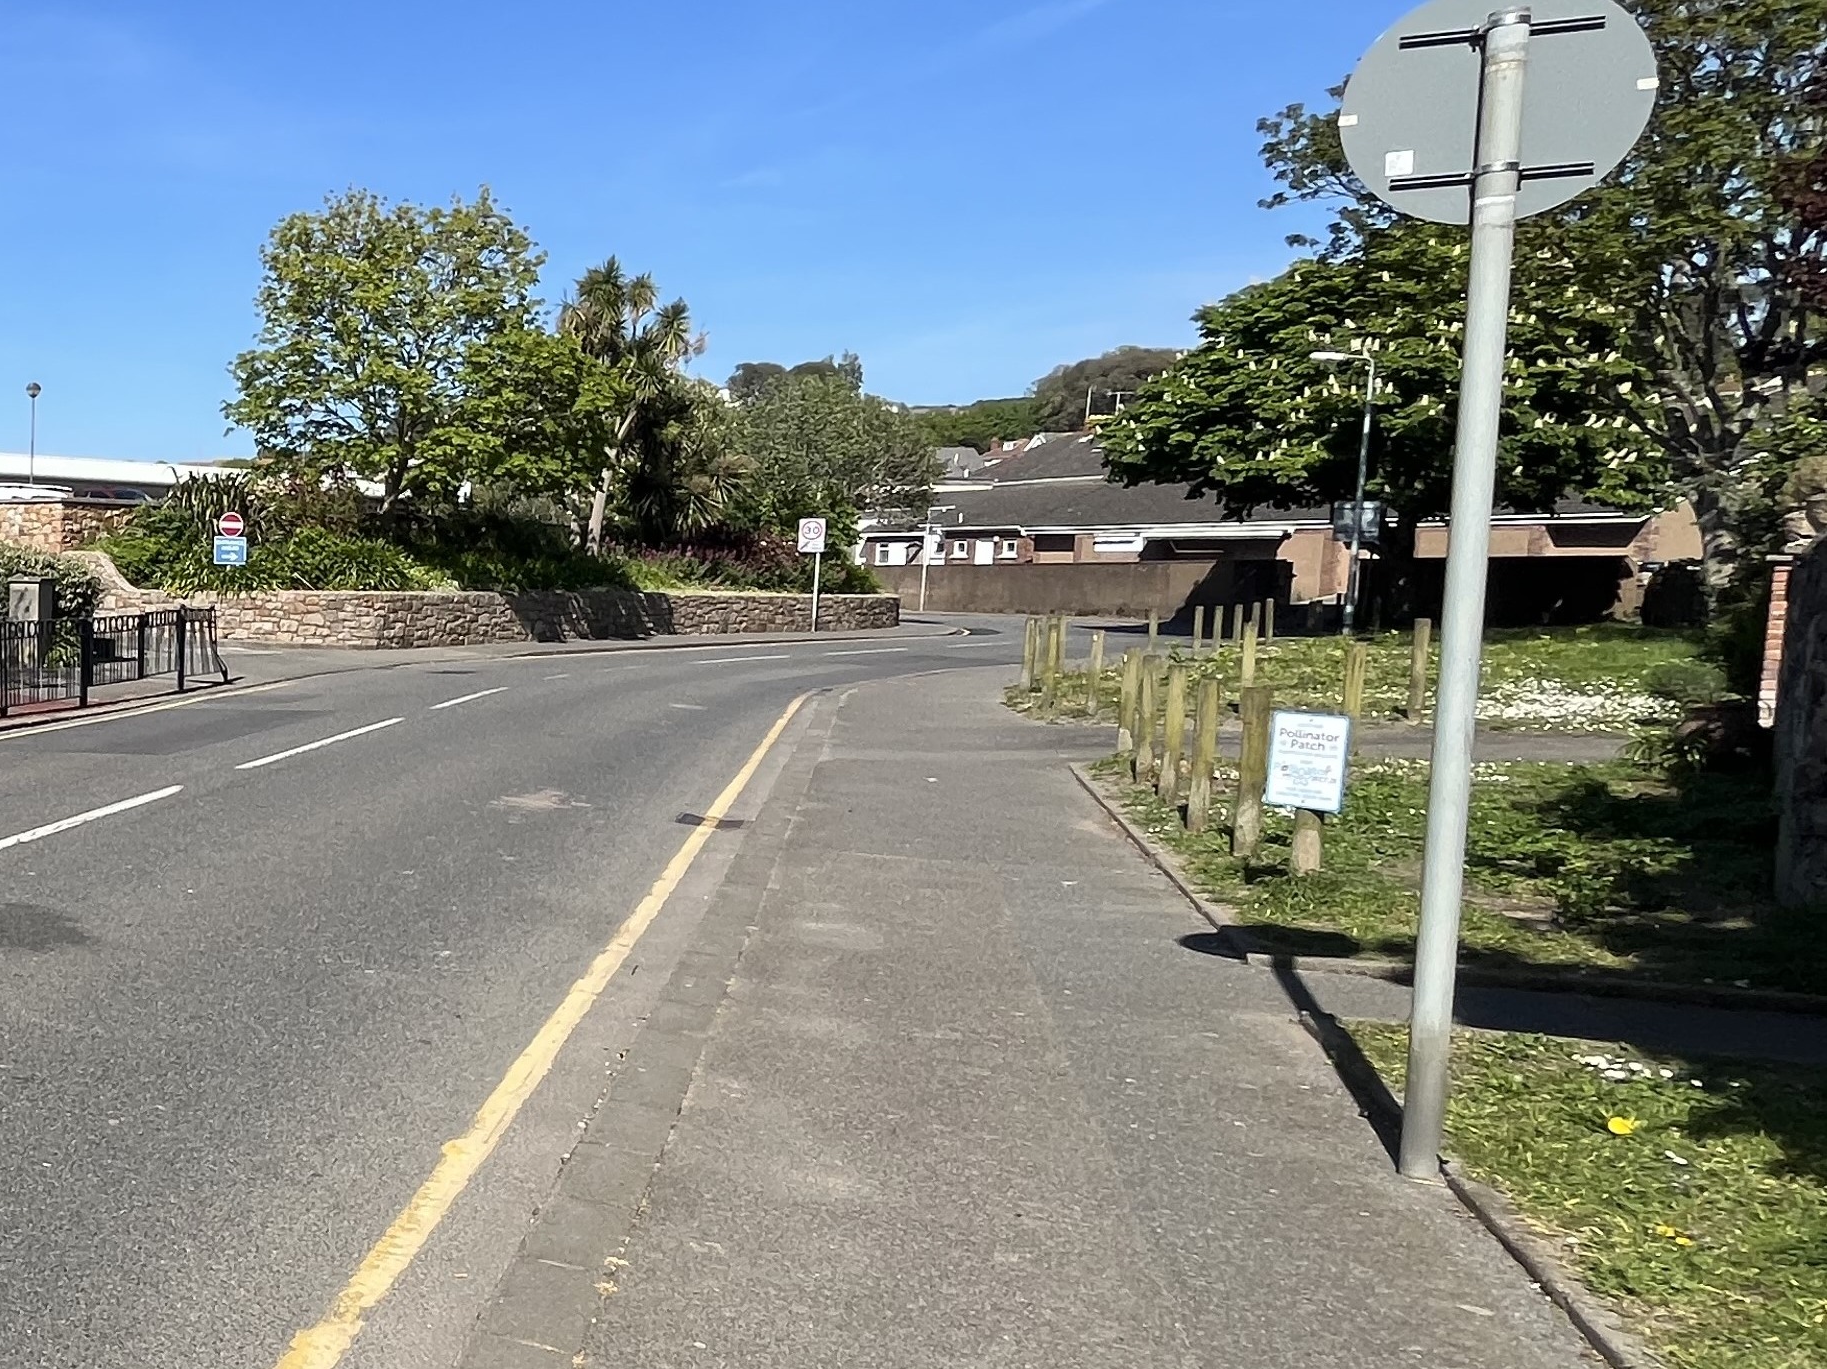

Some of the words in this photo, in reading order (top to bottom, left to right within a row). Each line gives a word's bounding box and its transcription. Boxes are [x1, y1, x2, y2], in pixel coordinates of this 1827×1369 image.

[804, 526, 820, 534] 30
[1279, 727, 1340, 742] Pollinator
[1290, 739, 1326, 751] Patch
